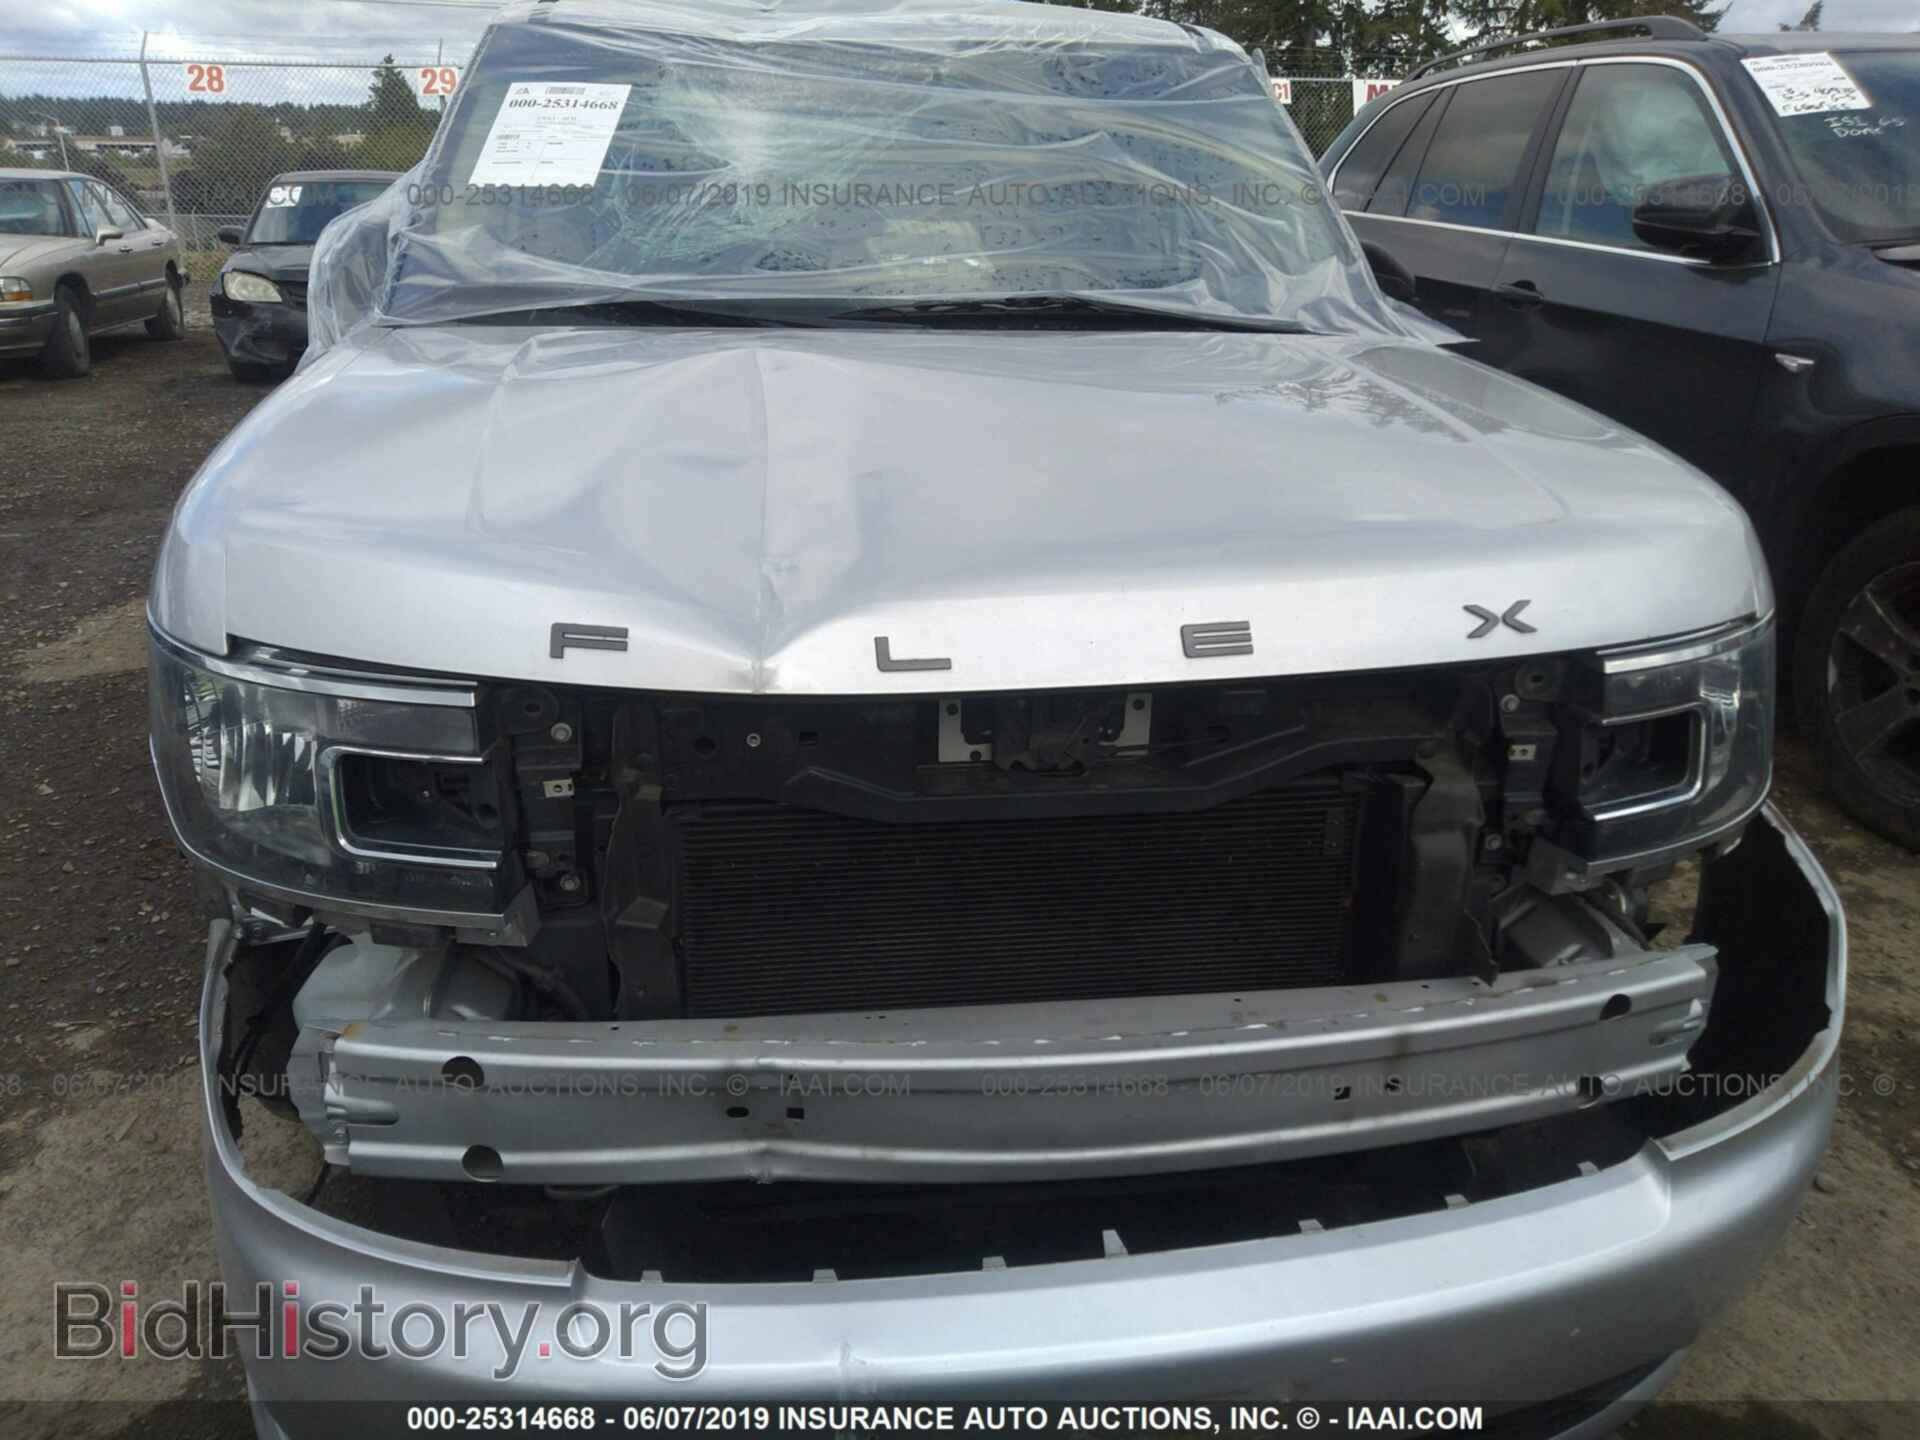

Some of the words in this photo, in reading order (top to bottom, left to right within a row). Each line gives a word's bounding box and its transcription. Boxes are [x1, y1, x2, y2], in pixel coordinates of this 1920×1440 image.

[187, 64, 225, 93] 28
[420, 68, 458, 96] 29
[508, 98, 619, 110] 000-25314668
